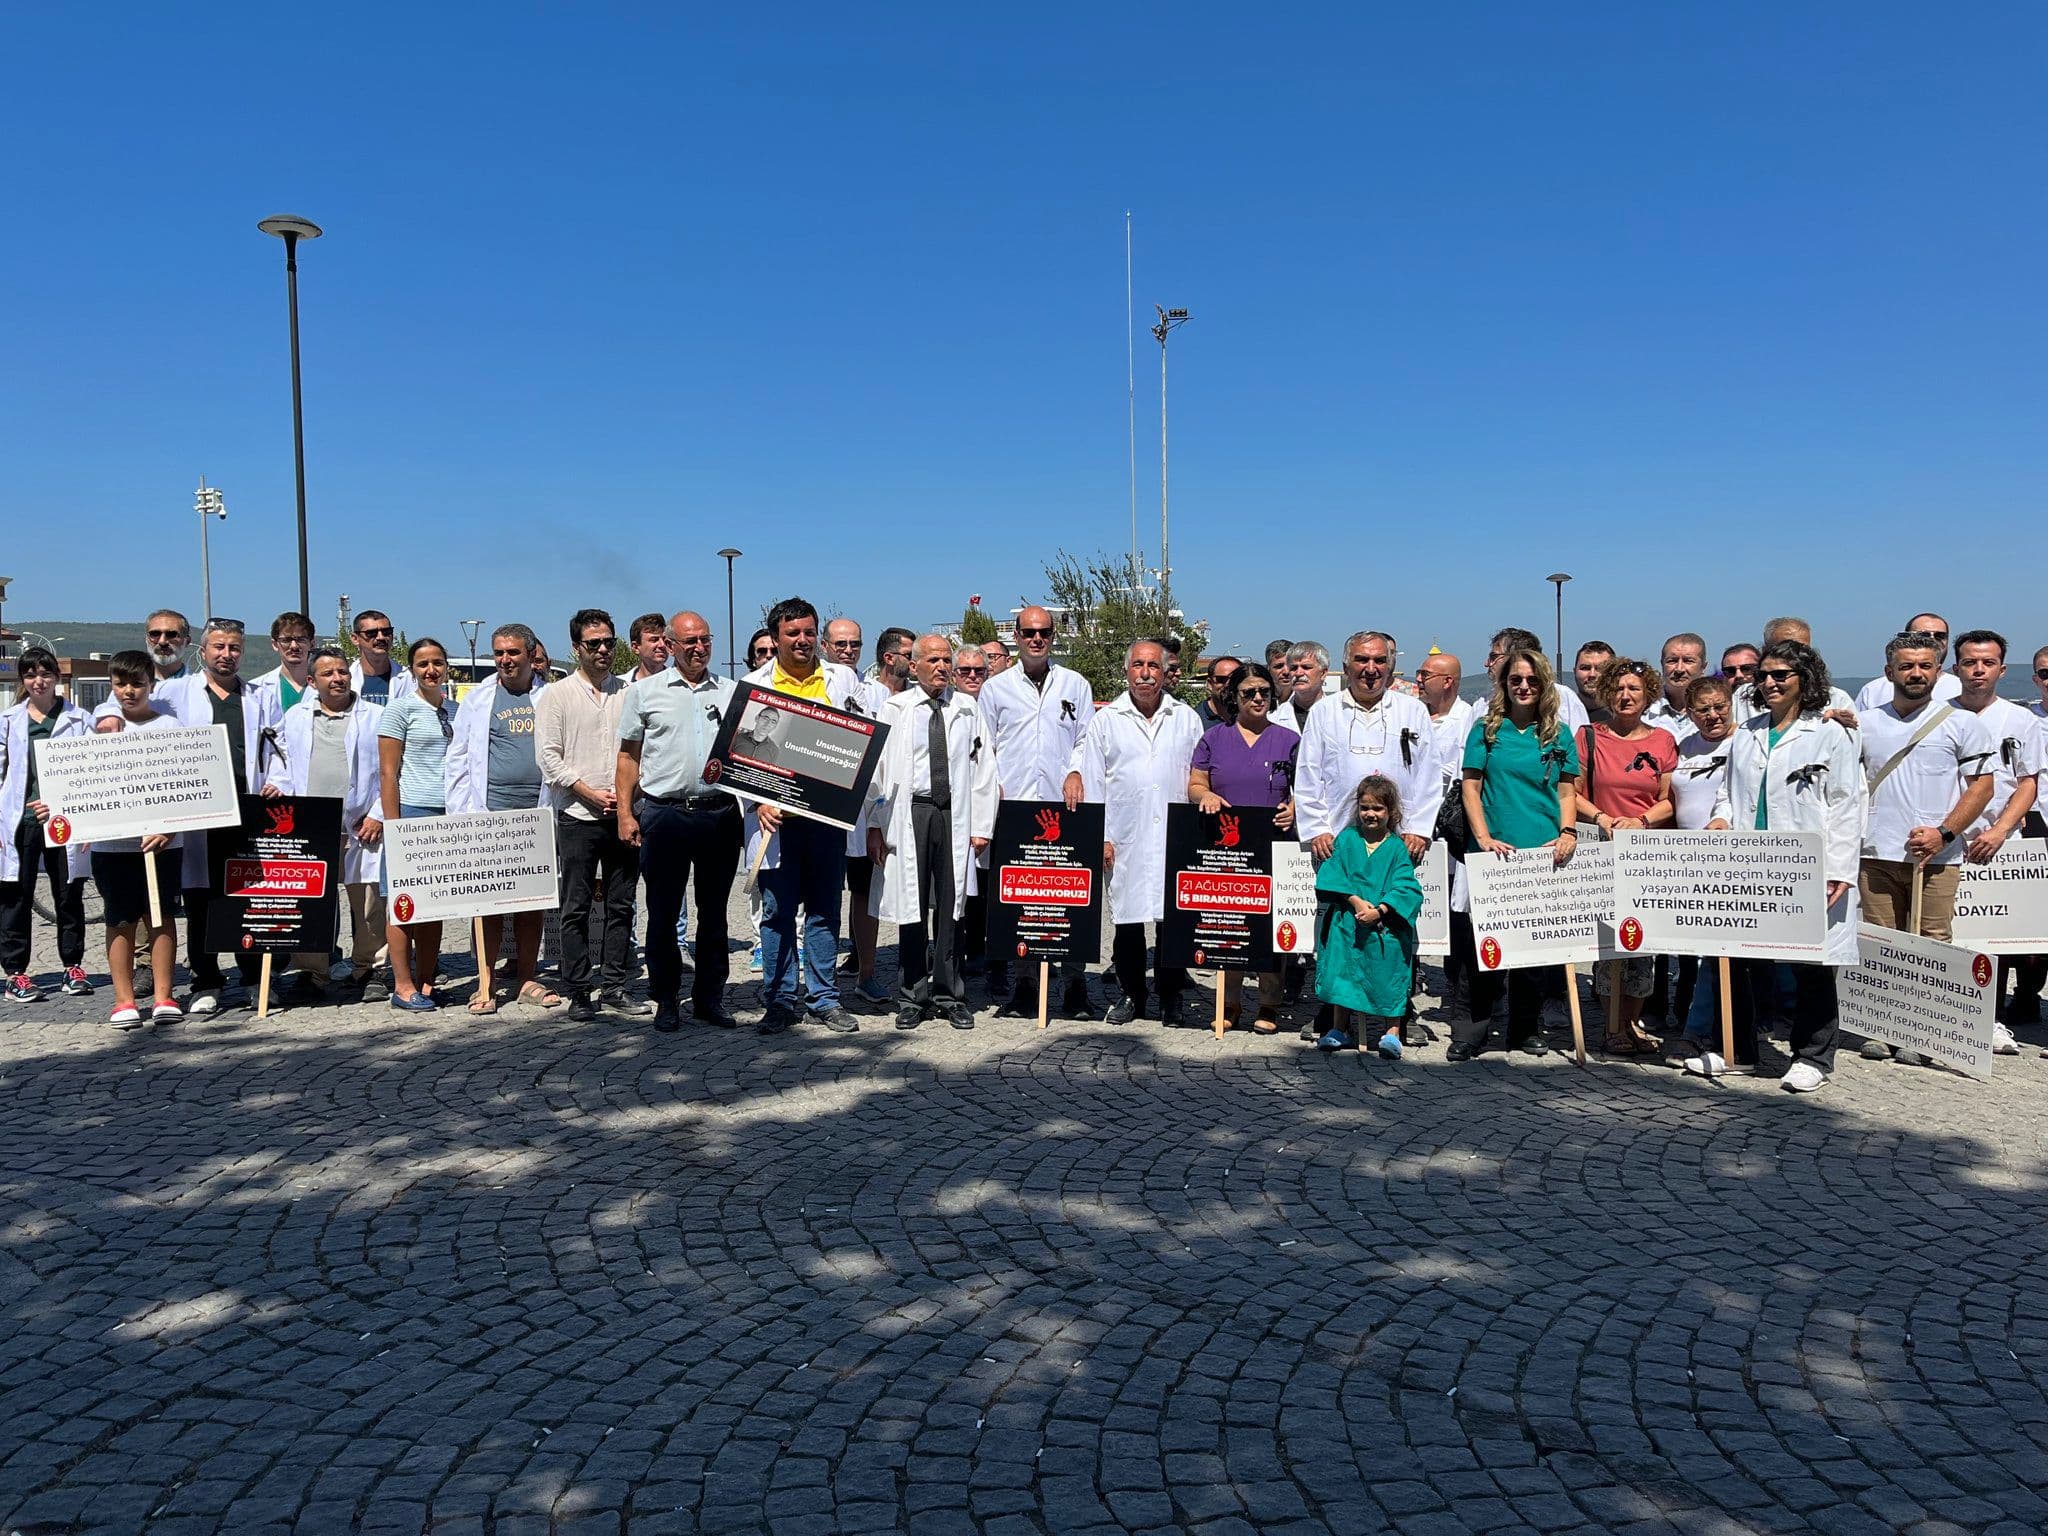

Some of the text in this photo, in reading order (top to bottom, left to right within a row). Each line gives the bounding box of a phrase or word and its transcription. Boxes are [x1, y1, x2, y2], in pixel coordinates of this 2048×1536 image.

[767, 696, 786, 706] Nisan
[787, 701, 810, 714] Volkan
[826, 713, 846, 725] Anma
[847, 720, 866, 731] Günü
[509, 718, 534, 732] 190
[45, 728, 211, 750] Anayasa'nın eşitlik ilkesine aykırı
[48, 751, 87, 764] diyerek
[173, 741, 211, 751] elinden
[784, 741, 858, 769] Unutturmayacağız!
[816, 739, 861, 759] Unutmadık!
[43, 753, 219, 777] alınarak eşitsizliğin öznesi yapılan,
[68, 775, 106, 788] eğitimi
[161, 768, 199, 777] dikkate
[62, 778, 208, 801] alınmayan TÜM VETERİNER
[62, 791, 212, 814] HEKİMLER için BURADAYIZ!
[396, 814, 539, 833] Yıllarını hayvan sağlığı, refahı
[416, 835, 438, 845] halk
[440, 833, 472, 845] sağlığı
[475, 831, 492, 842] için
[494, 827, 536, 840] çalışarak
[1631, 834, 1802, 848] Bilim üretmeleri gerekirken,
[405, 840, 535, 862] geçiren ama maaşları açlık
[1574, 847, 1600, 856] ücret
[1619, 850, 1816, 865] akademik çalışma koşullarından
[416, 856, 525, 872] sınırının da altına inen
[1288, 858, 1310, 868] iyileş
[1482, 863, 1551, 880] iyileştirilmeleri
[1594, 858, 1614, 868] hakl
[393, 865, 550, 888] EMEKLİ VETERİNER HEKİMLER
[1006, 873, 1086, 886] 21 AĞUSTOS'TA
[1488, 871, 1614, 892] açısından Veteriner Hekiml
[1624, 866, 1811, 882] uzaklaştırılan ve geçim kaygısı
[1960, 866, 2048, 881] ENCİLERİMİ
[244, 880, 307, 890] KAPALIYIZ!
[430, 881, 515, 899] için BURADAYIZ!
[1003, 885, 1088, 899] İŞ BIRAKIYORUZ!
[1182, 880, 1266, 894] 21 AĞUSTOS'TA
[1276, 882, 1300, 892] hariç
[1641, 883, 1792, 896] yaşayan AKADEMİSYEN
[1180, 891, 1268, 906] İŞ BIRAKIYORUZ!
[1286, 896, 1304, 906] ayrı
[1474, 885, 1614, 905] hariç denerek sağlık çalışanlar
[1278, 908, 1308, 916] KAMU
[1424, 910, 1442, 920] için
[1486, 899, 1615, 919] ayrı tutulan, haksızlığa uğra
[1632, 897, 1803, 916] VETERİNER HEKİMLER için
[1954, 904, 2008, 917] DAYIZ!
[1478, 911, 1615, 931] KAMU VETERİNER HEKİMLE
[1676, 915, 1757, 928] BURADAYIZ!
[1531, 927, 1593, 940] BURADAYIZ!
[1880, 946, 1946, 972] BURADAYIZ!
[1864, 958, 1982, 1000] VETERİNER HEKİMLER
[1843, 970, 1981, 1015] edilmeye çalışılan SERBEST
[1848, 986, 1974, 1030] ve orantısız cezalarla yok
[1837, 998, 1989, 1051] ama ağır bürokrasi yükü, haksı
[1842, 1015, 1975, 1065] Devletin yükünü hafifleten
